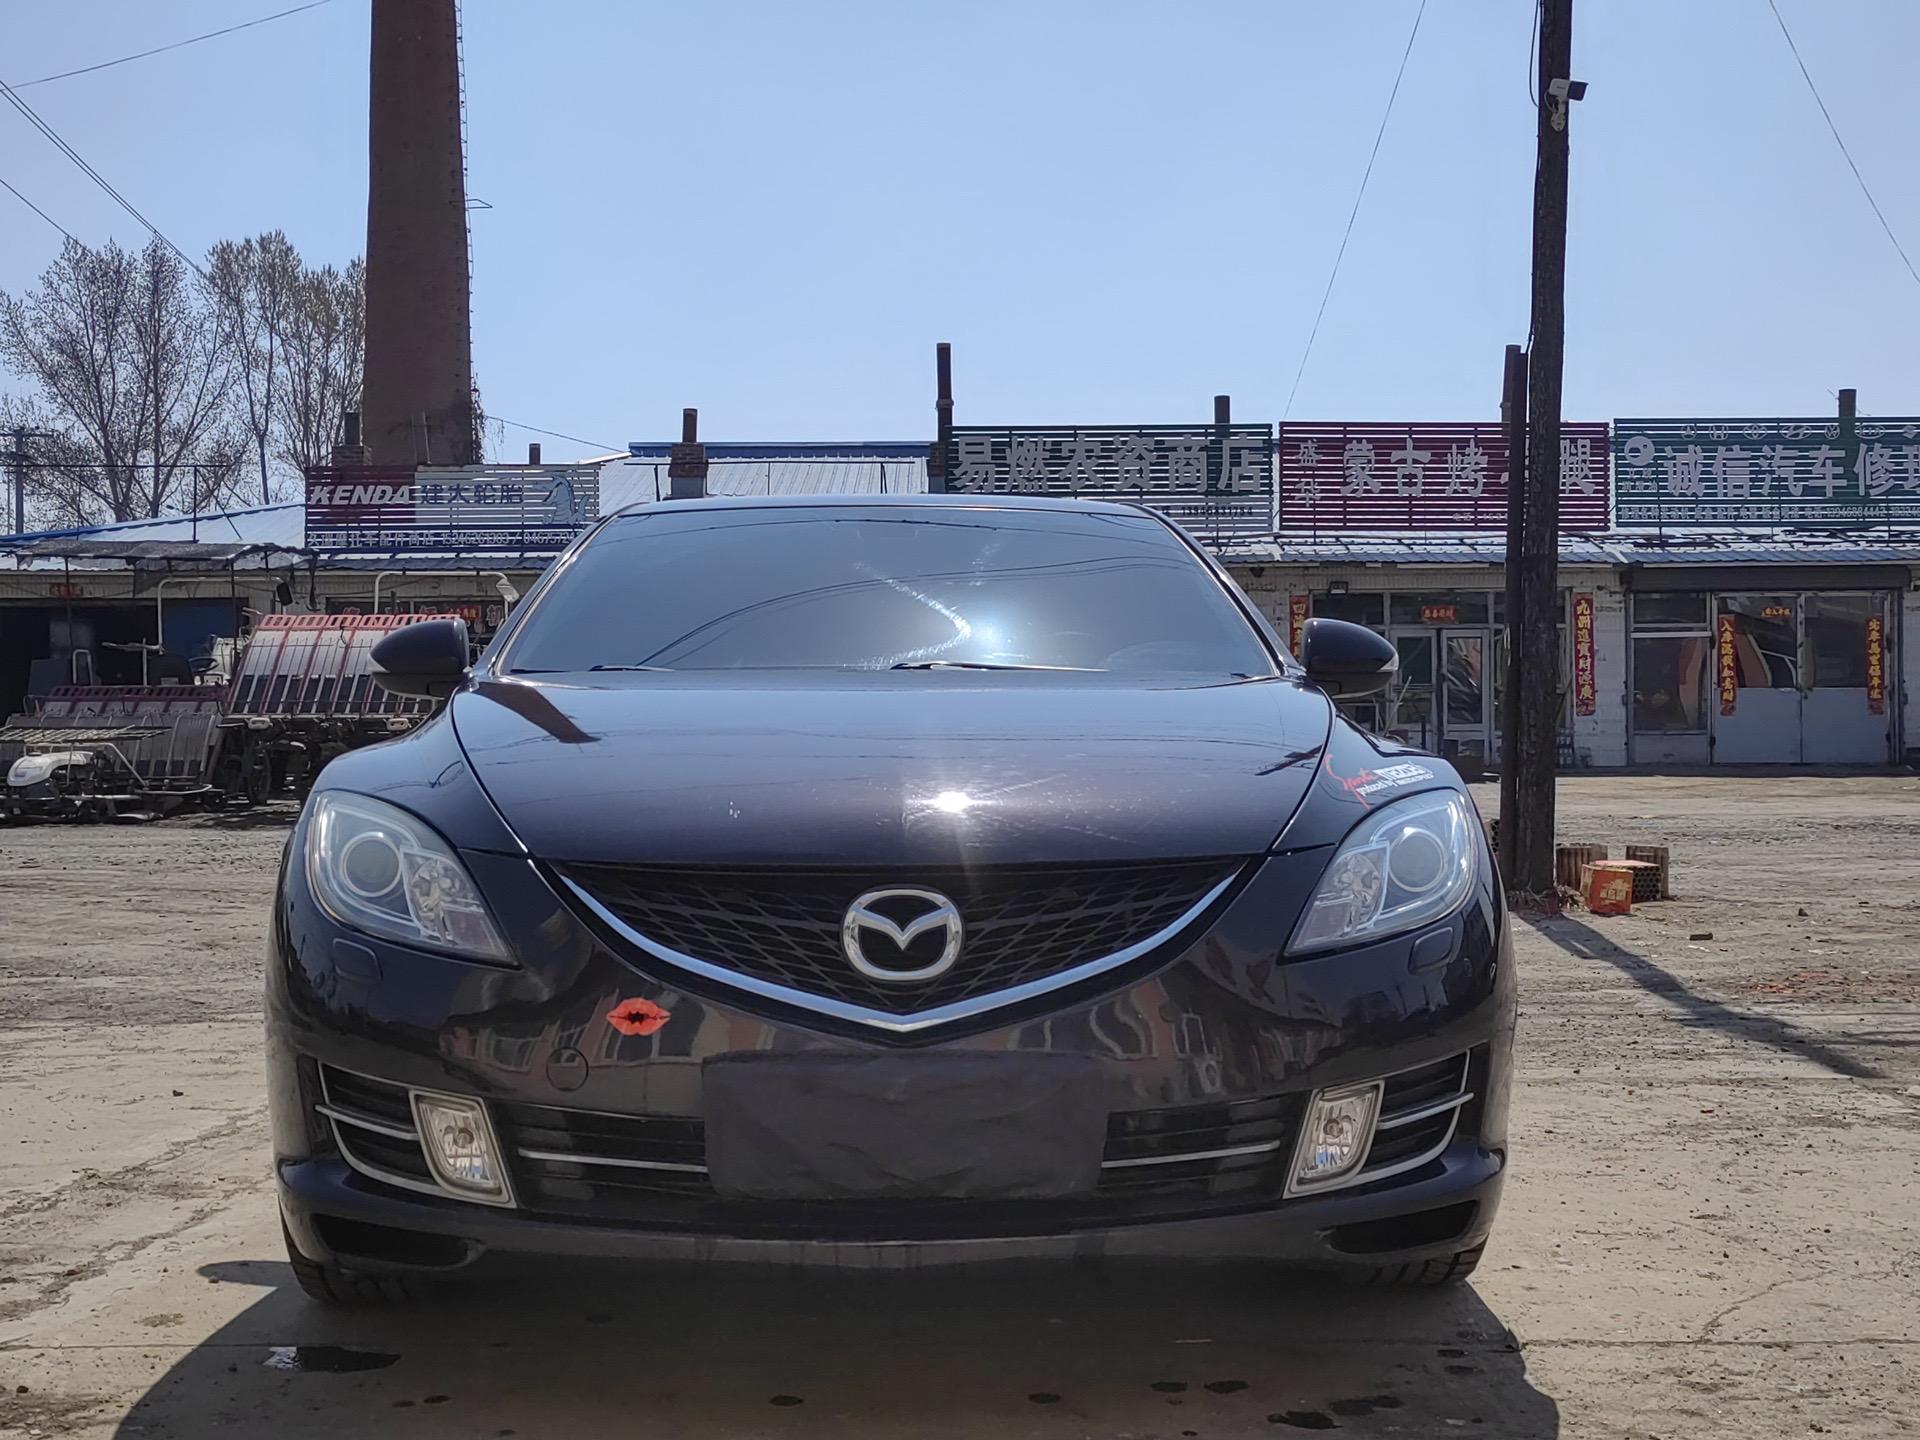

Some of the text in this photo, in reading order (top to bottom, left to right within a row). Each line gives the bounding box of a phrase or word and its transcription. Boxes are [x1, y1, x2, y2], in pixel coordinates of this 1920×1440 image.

[954, 434, 1264, 494] 易燃农资商店
[1339, 438, 1596, 497] 蒙古烤腿
[308, 484, 524, 505] KENDA 建大轮胎
